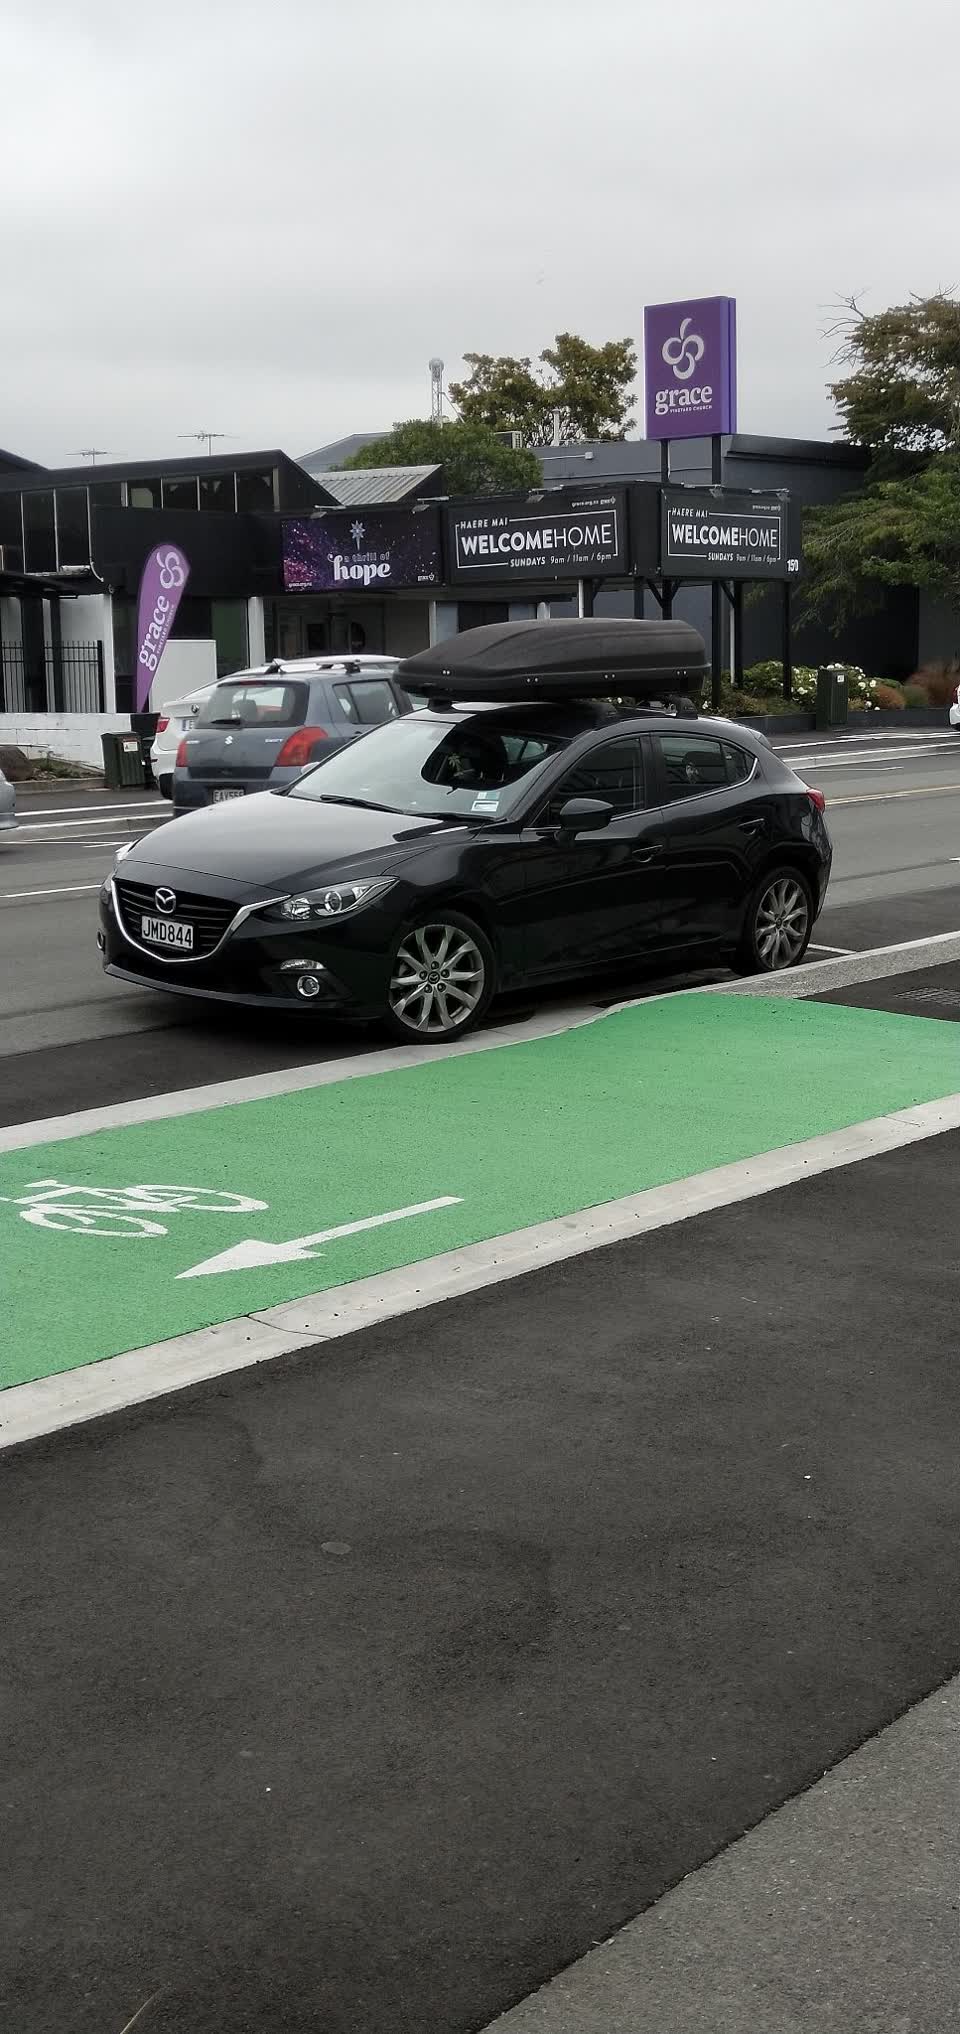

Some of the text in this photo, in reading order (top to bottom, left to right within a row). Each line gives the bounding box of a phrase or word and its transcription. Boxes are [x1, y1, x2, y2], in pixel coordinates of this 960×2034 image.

[654, 385, 713, 415] grace
[460, 517, 508, 529] HAERE MAI
[672, 507, 708, 518] HAERE MAI
[510, 556, 546, 568] SUNDAYS
[550, 555, 565, 564] 9am
[573, 554, 589, 563] 11am
[596, 552, 612, 563] 6pm
[708, 552, 734, 561] SUNDAYS
[327, 553, 392, 586] hope
[139, 595, 170, 672] grace
[143, 919, 193, 947] JMD844
